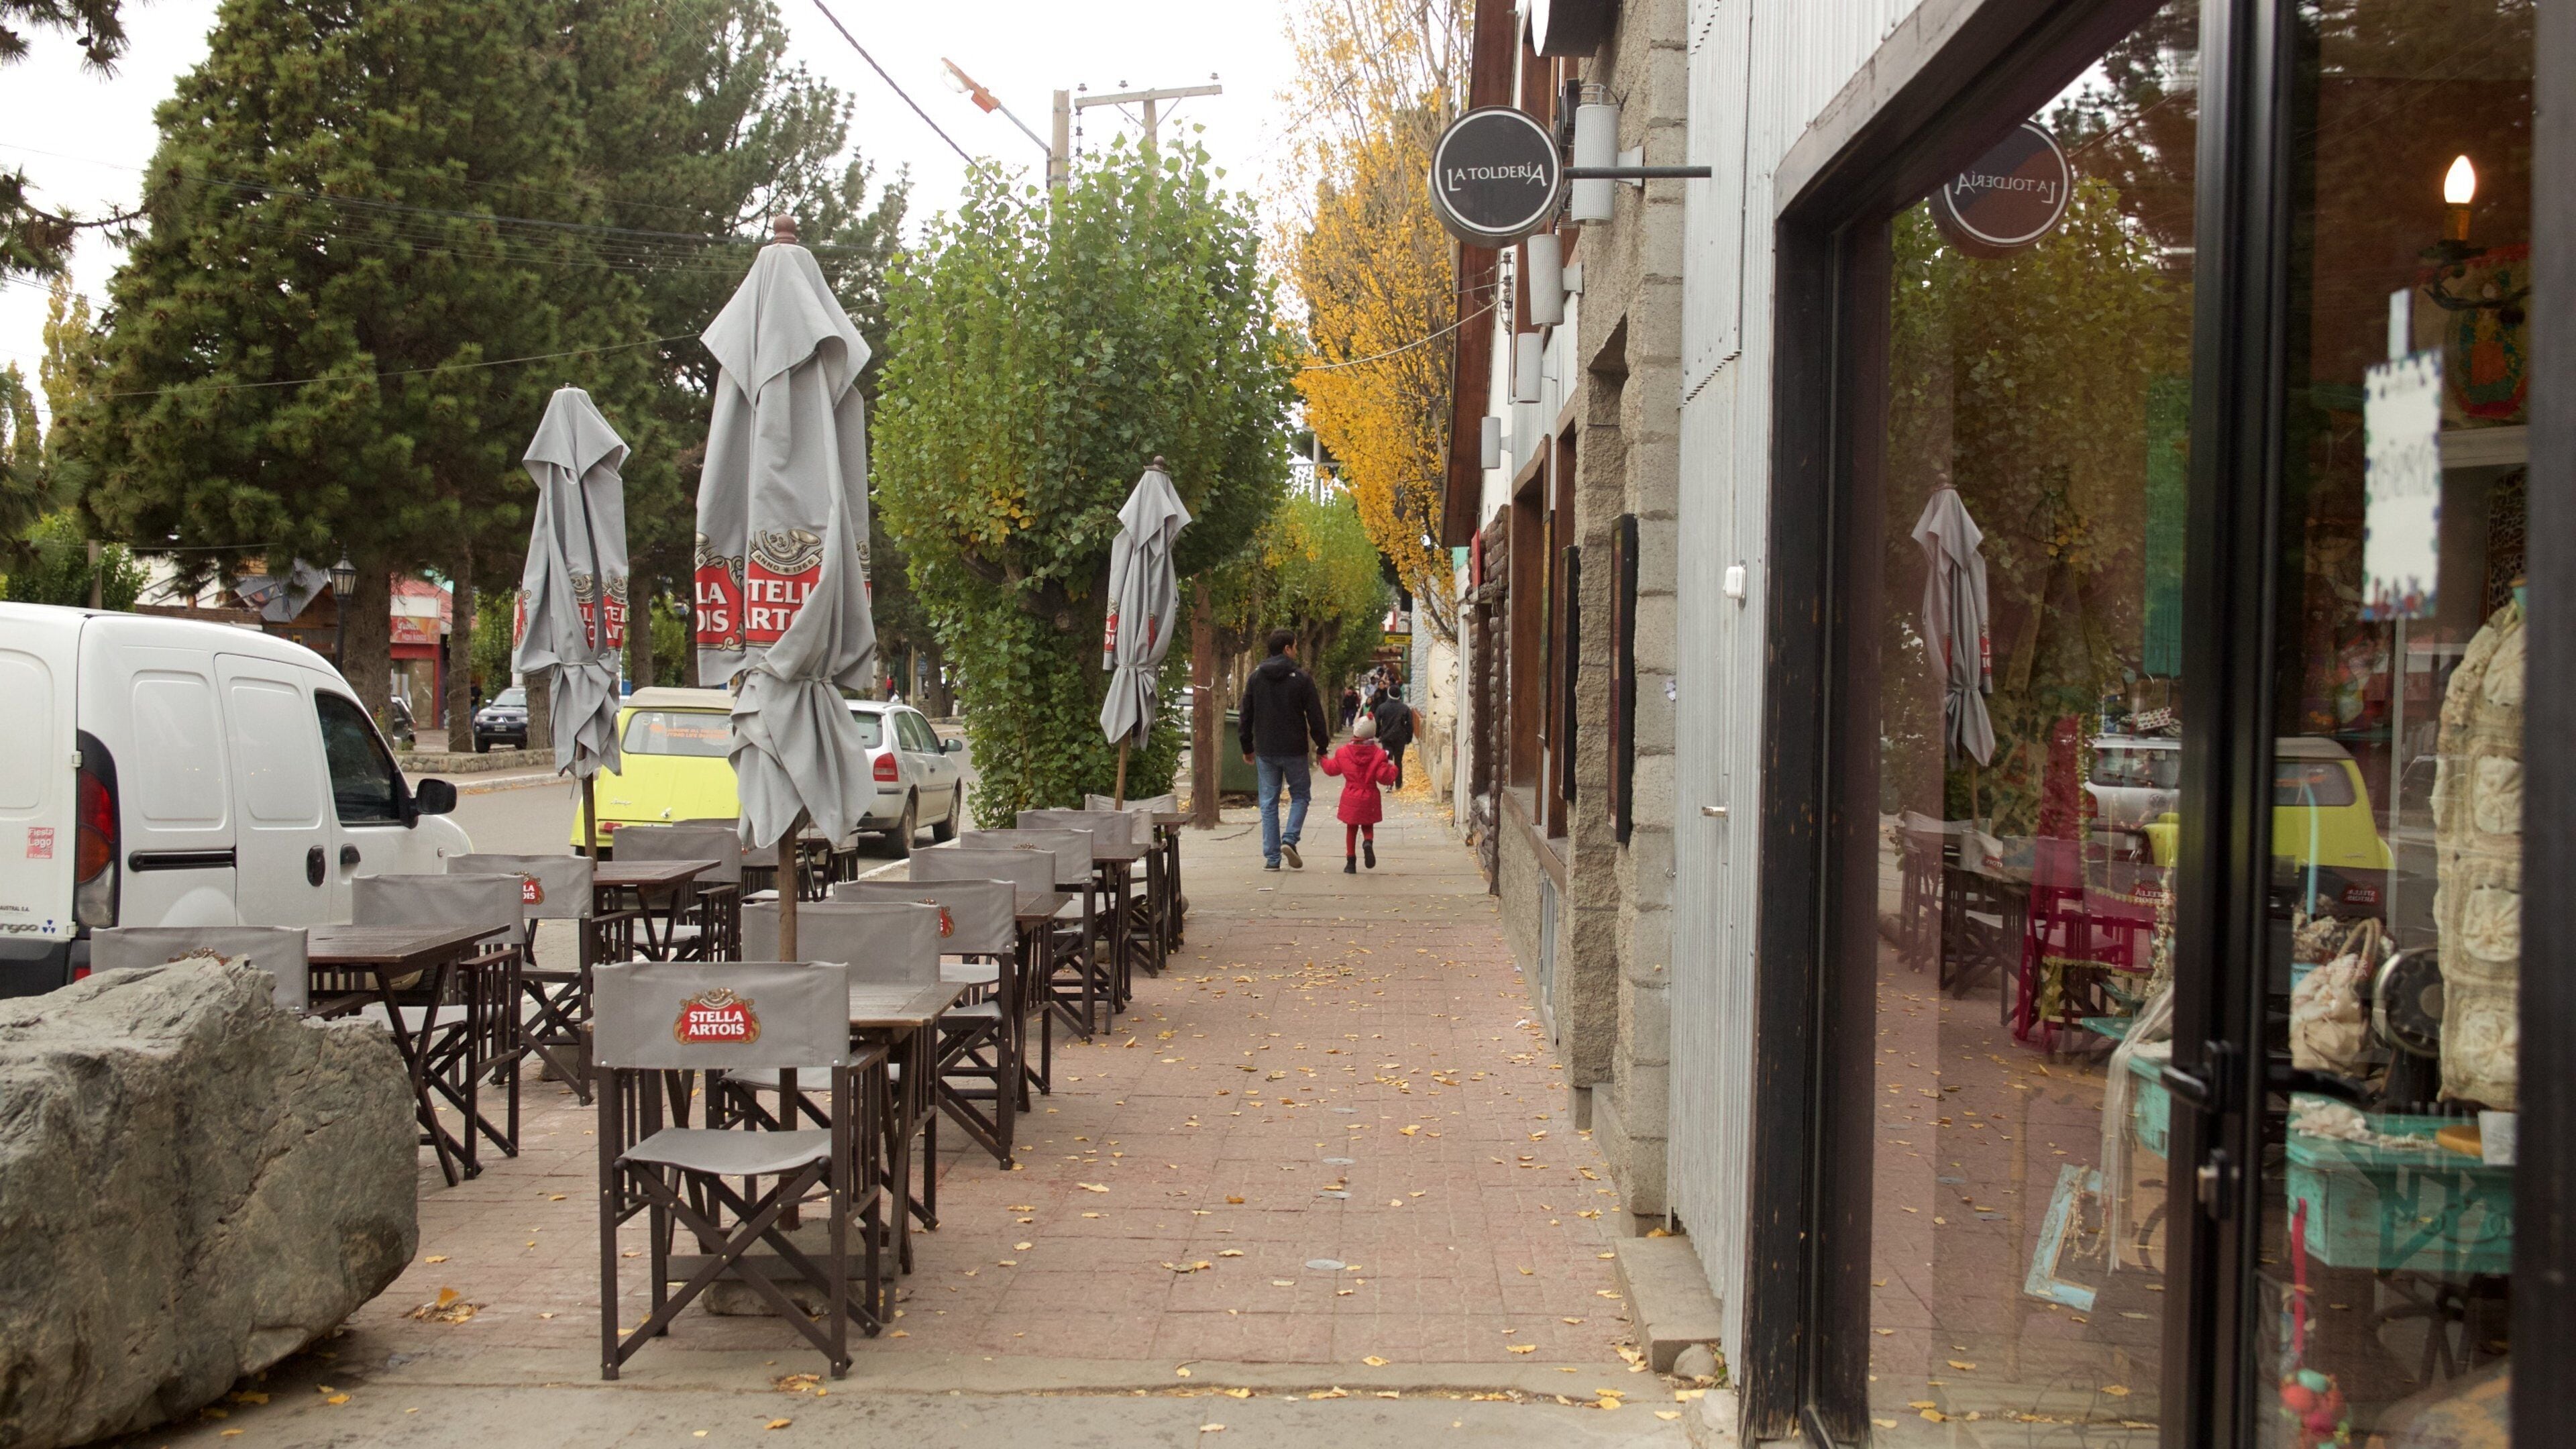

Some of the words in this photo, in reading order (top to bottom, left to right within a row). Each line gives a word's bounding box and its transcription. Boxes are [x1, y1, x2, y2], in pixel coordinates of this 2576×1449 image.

[1447, 168, 1466, 192] LA
[755, 554, 780, 572] ANNO
[793, 558, 814, 573] 1366
[748, 578, 812, 604] TELL
[29, 828, 54, 837] Fiesta
[28, 837, 52, 848] Lago
[689, 1010, 745, 1023] STELLA
[688, 1023, 745, 1036] ARTOIS
